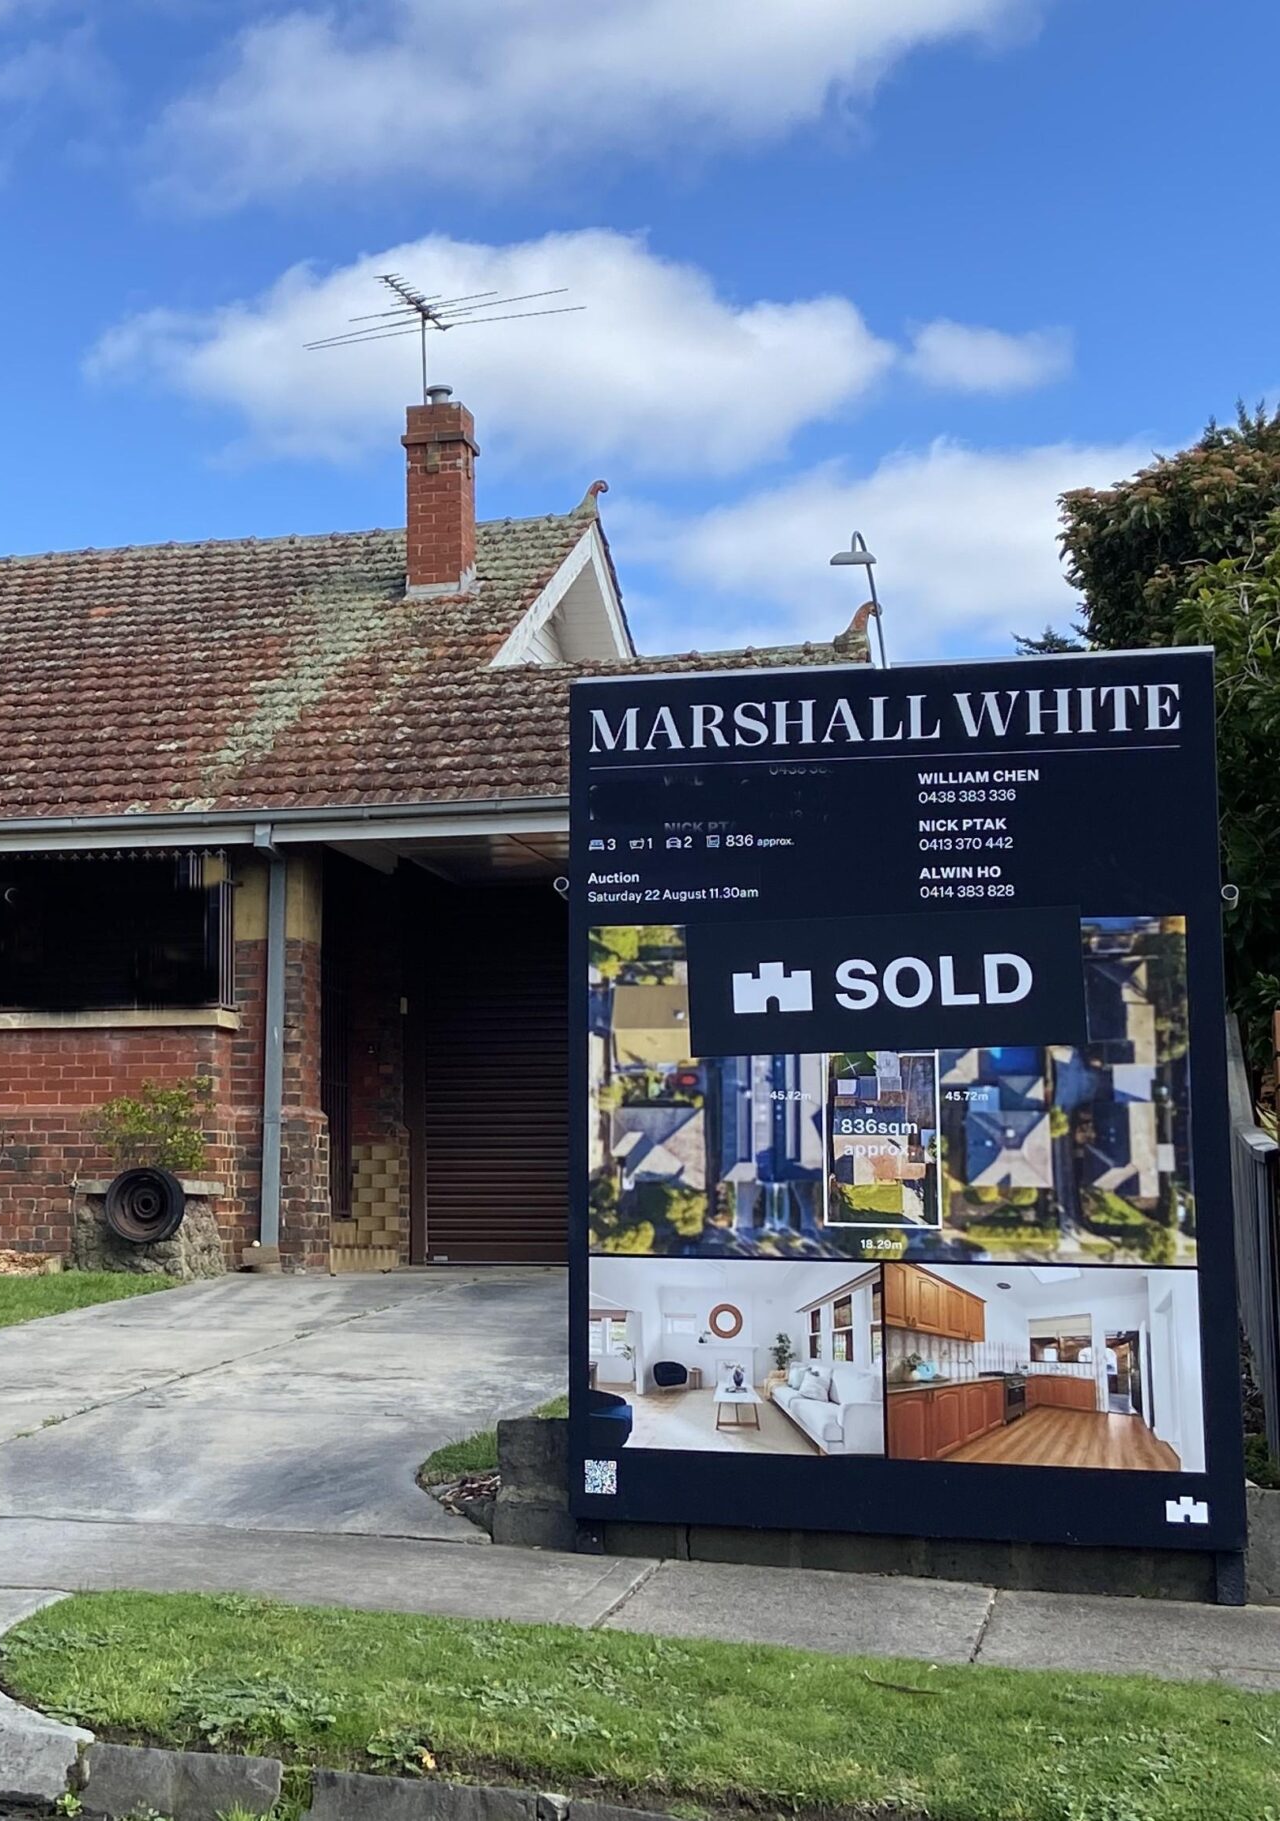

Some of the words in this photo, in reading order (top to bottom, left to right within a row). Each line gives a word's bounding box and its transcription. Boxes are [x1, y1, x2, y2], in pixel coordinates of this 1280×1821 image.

[589, 695, 941, 752] MARSHALL
[953, 684, 1180, 738] WHITE
[918, 771, 989, 784] WILLIAM
[993, 769, 1040, 782] CHEN
[918, 790, 956, 804] 0438
[959, 790, 986, 802] 383
[989, 789, 1016, 801] 336
[919, 819, 959, 832] NICK
[962, 818, 1007, 831] PTAK
[607, 839, 616, 850] 3
[683, 836, 693, 848] 2
[725, 834, 754, 847] 836
[757, 836, 795, 847] approx.
[919, 838, 953, 851] 0413
[955, 837, 982, 850] 370
[985, 836, 1014, 849] 442
[587, 872, 640, 884] Auction
[919, 867, 973, 879] ALWIN
[977, 865, 1002, 878] HO
[587, 890, 642, 903] Saturday
[644, 889, 660, 901] 22
[662, 888, 707, 902] August
[709, 886, 759, 899] 11.30am
[920, 886, 954, 899] 0414
[957, 885, 984, 898] 383
[987, 884, 1015, 897] 828
[835, 953, 1033, 1010] SOLD
[945, 1090, 989, 1101] 45.72m
[840, 1118, 918, 1139] 836sqm
[843, 1142, 916, 1159] approx.
[860, 1239, 903, 1250] 18.29m
